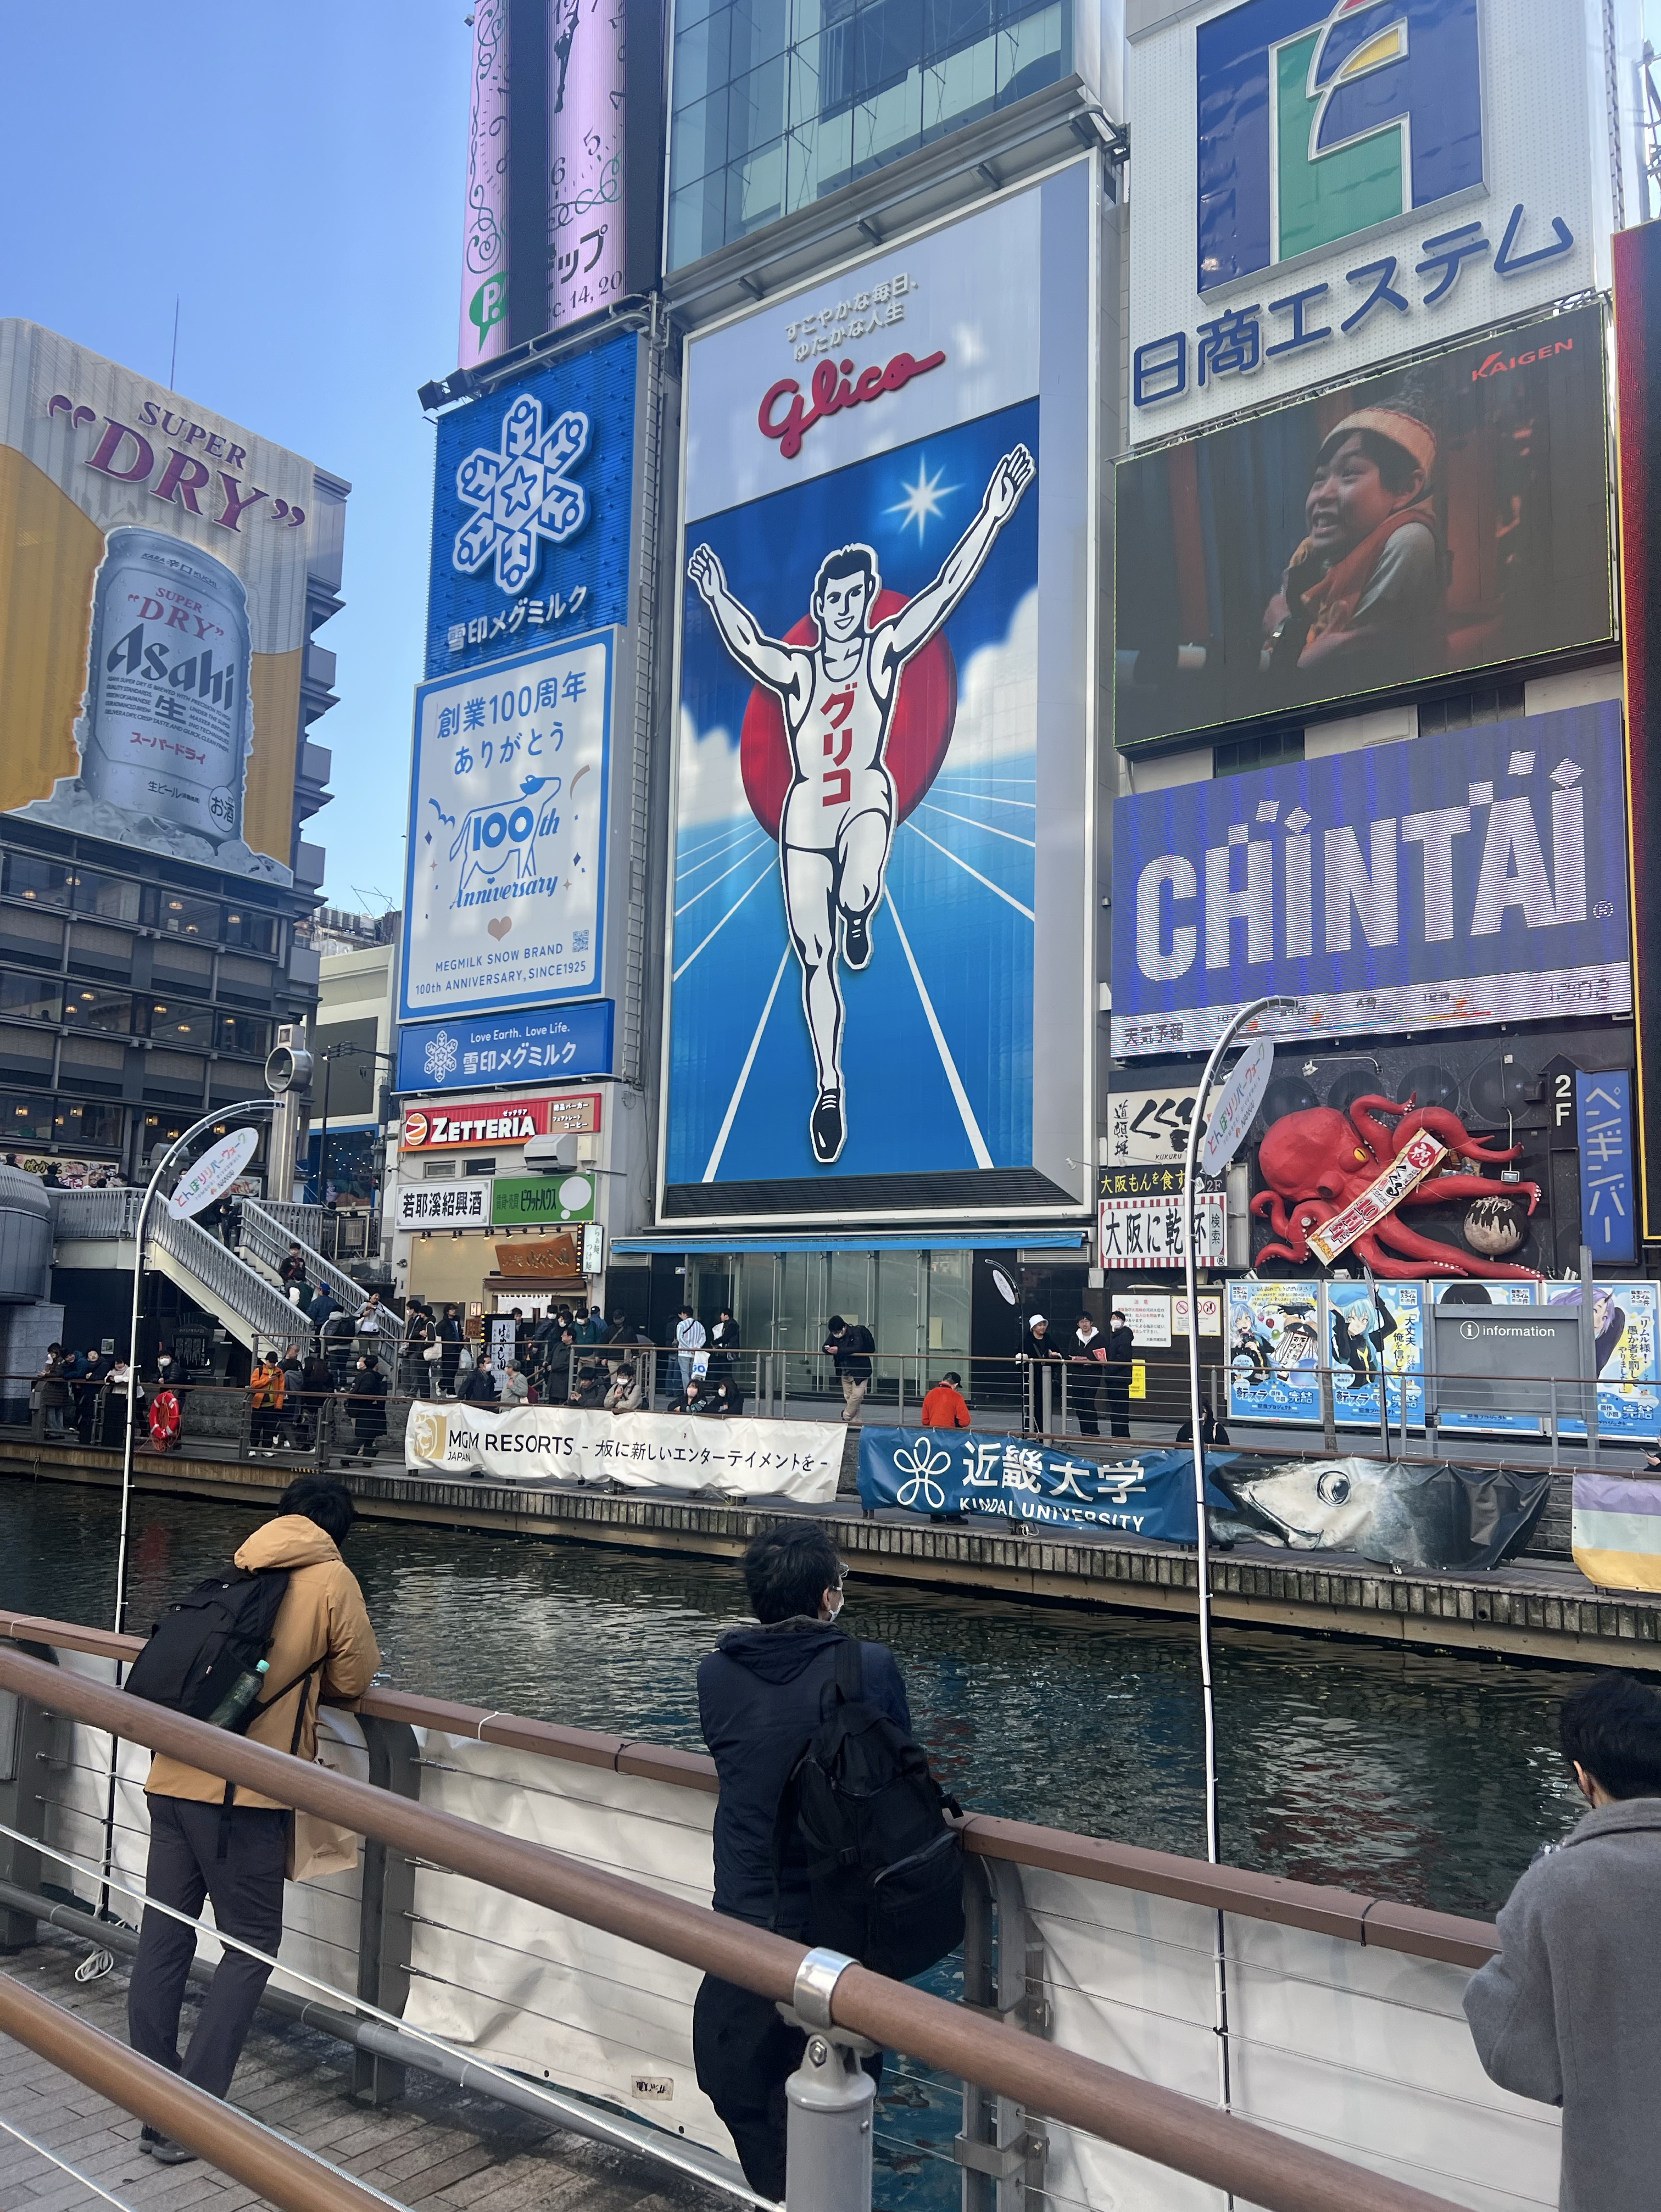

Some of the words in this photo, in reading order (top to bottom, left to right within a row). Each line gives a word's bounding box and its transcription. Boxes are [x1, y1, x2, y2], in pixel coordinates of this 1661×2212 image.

[1133, 203, 1575, 409] 日商エステム
[794, 301, 905, 362] ゆたかな人生
[1472, 338, 1573, 381] KAIGEN
[138, 401, 247, 470] SUPER
[141, 553, 165, 563] KARA
[193, 571, 217, 587] KUCHI
[156, 587, 202, 614] SUPER
[447, 585, 588, 654] 雪印メグミルク
[107, 623, 234, 711] Asahi
[155, 695, 186, 725] 生
[437, 671, 586, 739] 創業100周年
[130, 732, 206, 765] スーパードライ
[454, 721, 564, 775] ありがとう
[820, 682, 858, 807] グリコ
[147, 781, 181, 798] 生ビール
[211, 796, 235, 825] お酒
[473, 806, 560, 852] 100th
[449, 876, 558, 910] Anniversary
[436, 956, 482, 973] MEGMILK
[487, 950, 519, 965] SNOW
[524, 943, 564, 959] BRAND
[416, 983, 441, 995] 100th
[471, 1032, 491, 1043] Love
[493, 1028, 522, 1041] Earth.
[526, 1025, 548, 1038] Love
[549, 1021, 570, 1034] Life.
[463, 1041, 577, 1075] 雪印メグミルク
[431, 1116, 536, 1143] ZETTERIA
[502, 1109, 529, 1117] ゼッテリア
[564, 1121, 589, 1130] コーヒー
[1129, 1097, 1208, 1153] くくる
[1584, 1086, 1626, 1244] ペンギンバー
[1207, 1179, 1223, 1192] 2F
[1211, 1213, 1221, 1245] 検索
[1483, 1325, 1555, 1337] information
[1288, 1390, 1313, 1405] 完結
[447, 1451, 471, 1462] JAPAN
[449, 1430, 479, 1449] MGM
[485, 1433, 574, 1455] RESORTS
[962, 1442, 1147, 1504] 近畿大学
[960, 1497, 1013, 1516] KINDAI
[1021, 1501, 1145, 1532] UNIVERSITY
